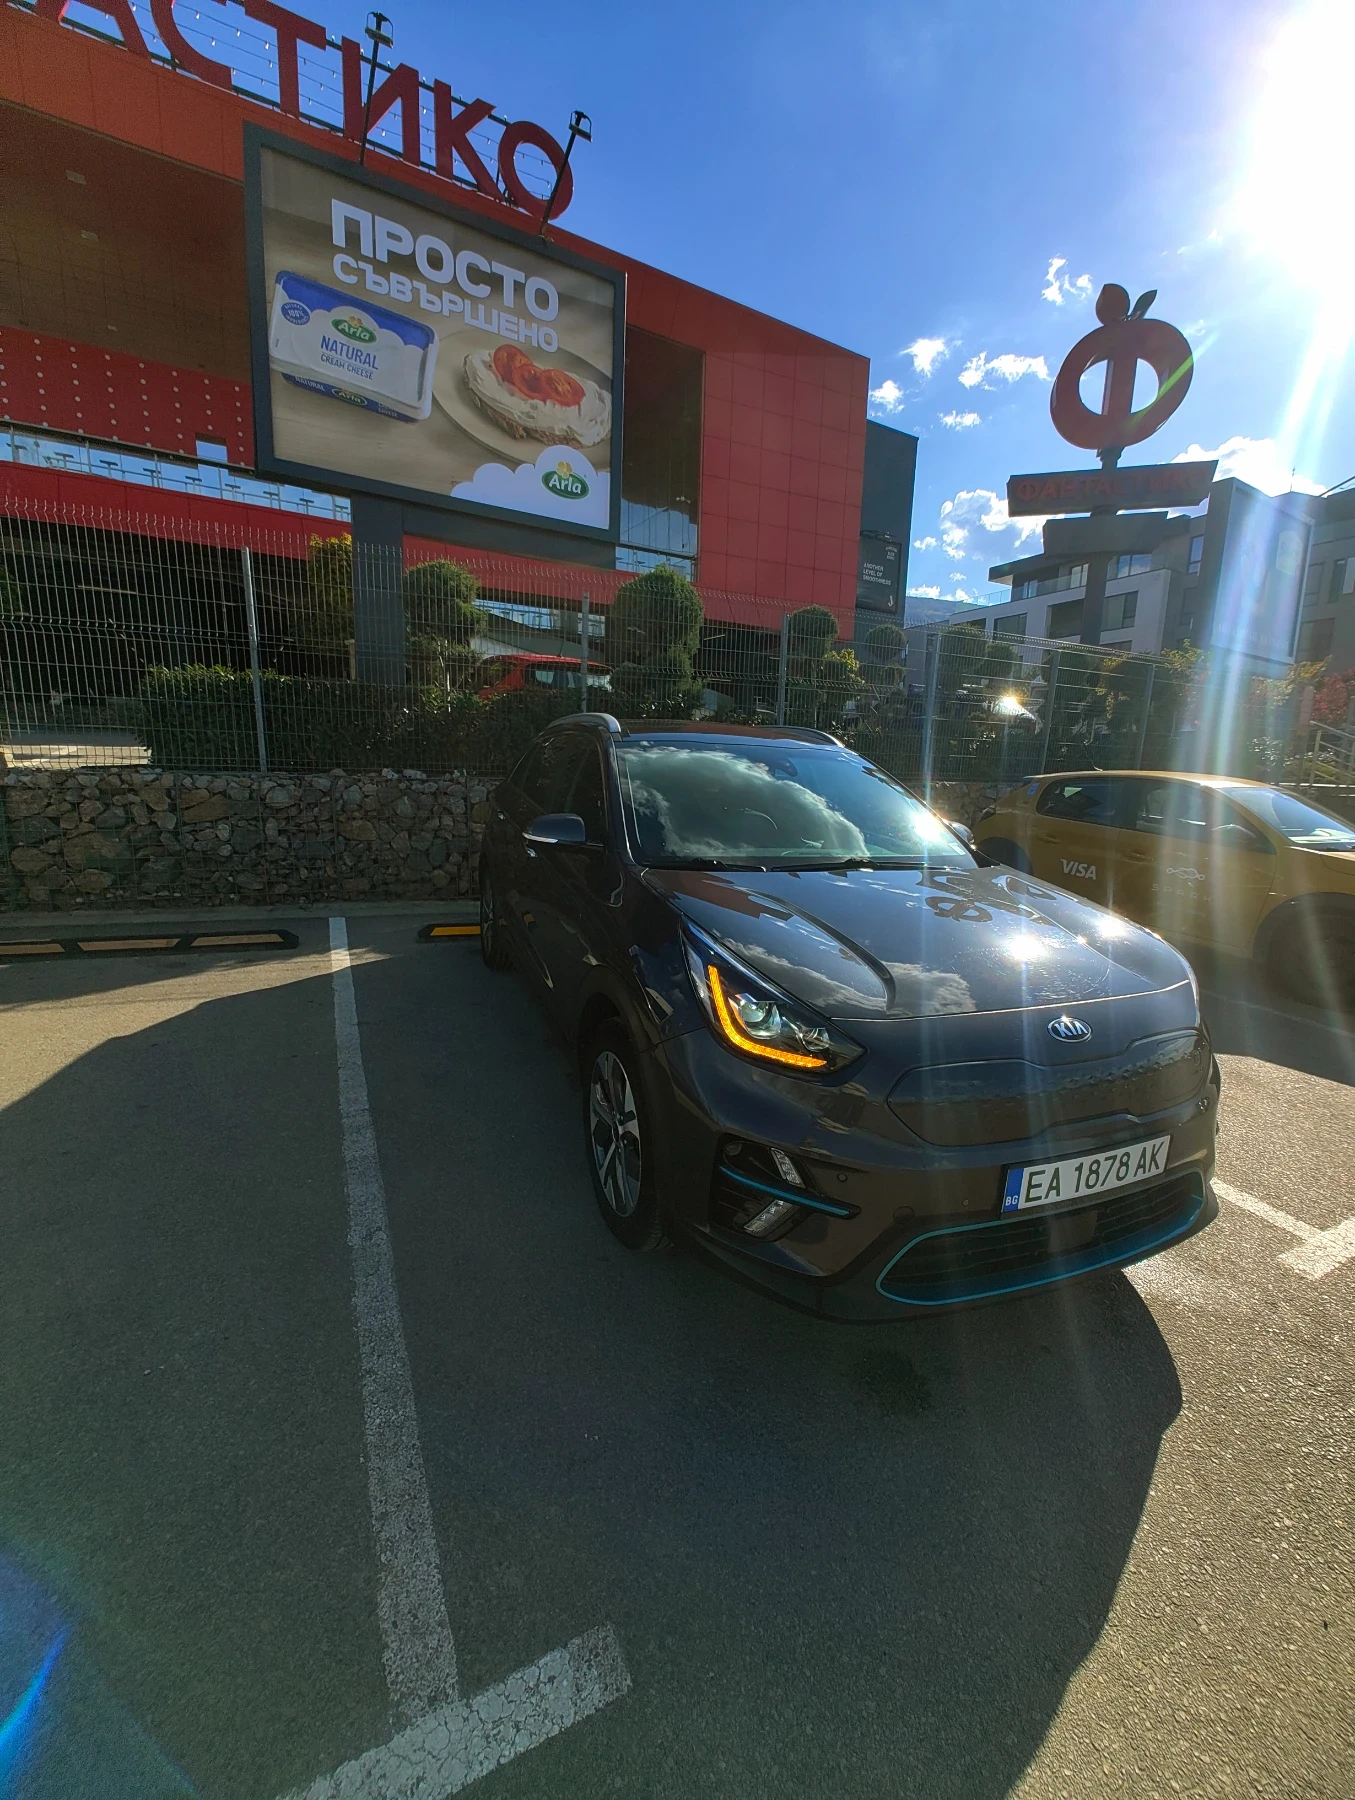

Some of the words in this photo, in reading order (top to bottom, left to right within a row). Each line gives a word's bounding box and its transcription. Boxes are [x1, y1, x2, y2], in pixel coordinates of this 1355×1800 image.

[331, 198, 559, 322] ПРОСТО
[332, 253, 559, 353] СЪВЪРШЕНО
[338, 323, 370, 341] Arla
[320, 335, 379, 371] NATURAL
[320, 353, 345, 371] CREAM
[348, 363, 374, 380] CHEESE
[548, 473, 582, 494] Arla
[863, 568, 876, 576] LEVEL
[1060, 859, 1097, 880] VISA
[1053, 1019, 1088, 1038] KIA
[1024, 1166, 1061, 1203] EA
[1074, 1151, 1131, 1193] 1878
[1133, 1140, 1165, 1178] AK
[1005, 1194, 1019, 1207] BG
